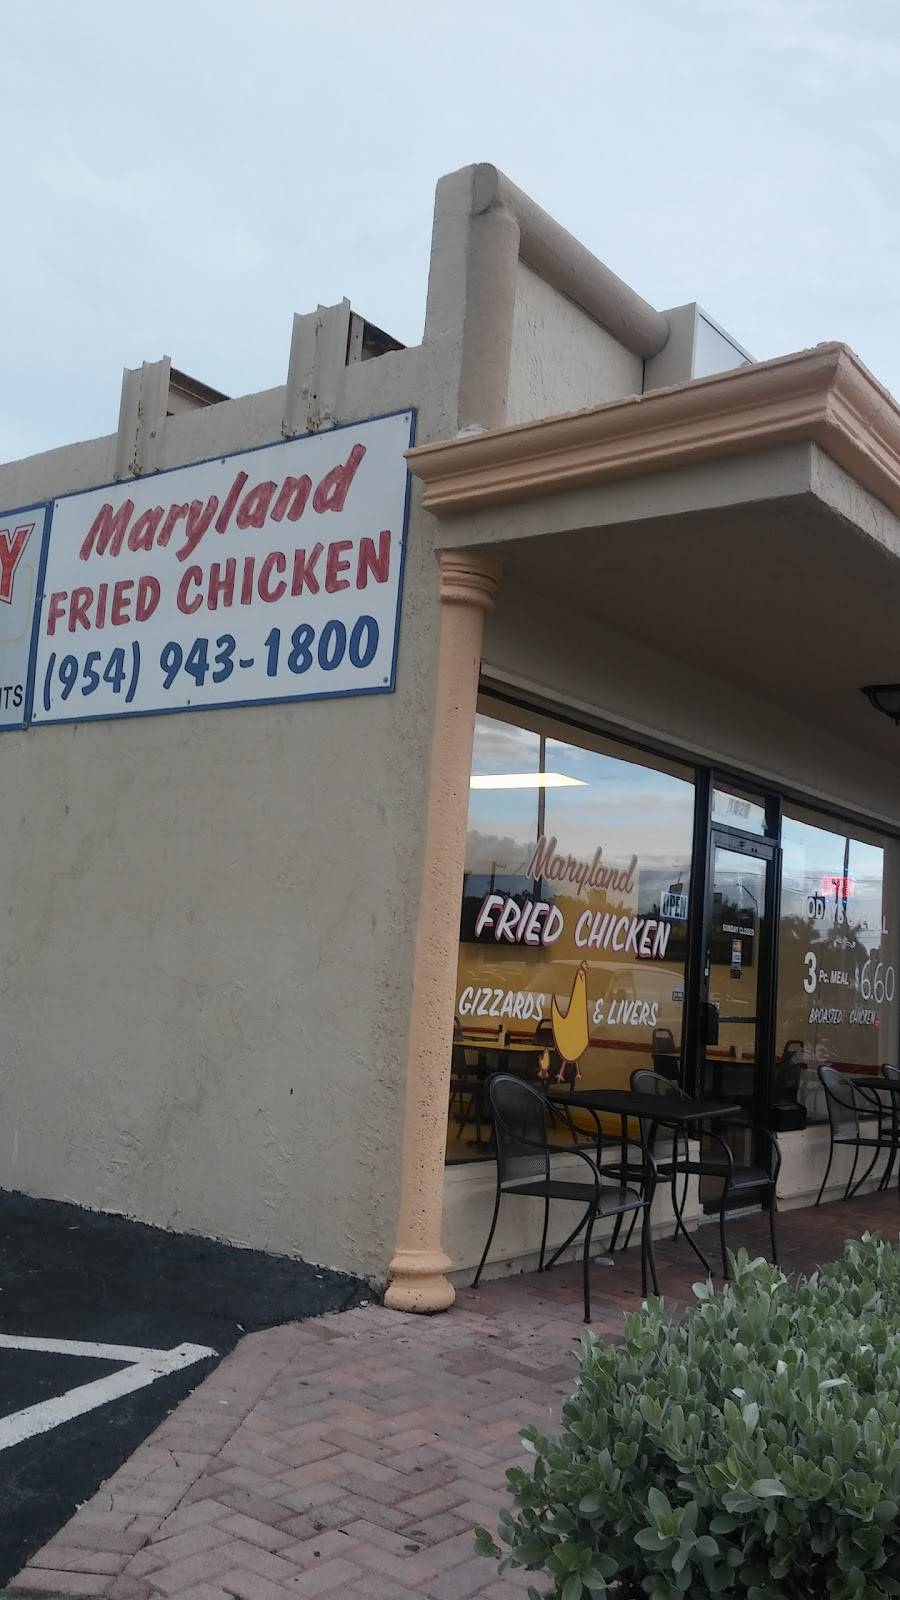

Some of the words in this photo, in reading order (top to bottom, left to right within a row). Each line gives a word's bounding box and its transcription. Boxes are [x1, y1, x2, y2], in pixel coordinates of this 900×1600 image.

[79, 443, 367, 562] Maryland
[46, 576, 161, 636] FRIED
[176, 530, 392, 615] CHICKEN
[44, 640, 141, 711] (954)
[159, 615, 380, 690] 943-1800
[526, 835, 638, 896] Maryland
[475, 894, 565, 946] FRIED
[574, 909, 672, 959] CHICKEN
[662, 893, 687, 918] OPEN
[722, 923, 739, 934] SUNDAY
[739, 926, 755, 937] CLOSED
[803, 951, 817, 994] 3
[830, 970, 849, 986] MEAL
[458, 986, 546, 1021] GIZZARDS
[592, 998, 604, 1025] &
[607, 1000, 659, 1027] LIVERS
